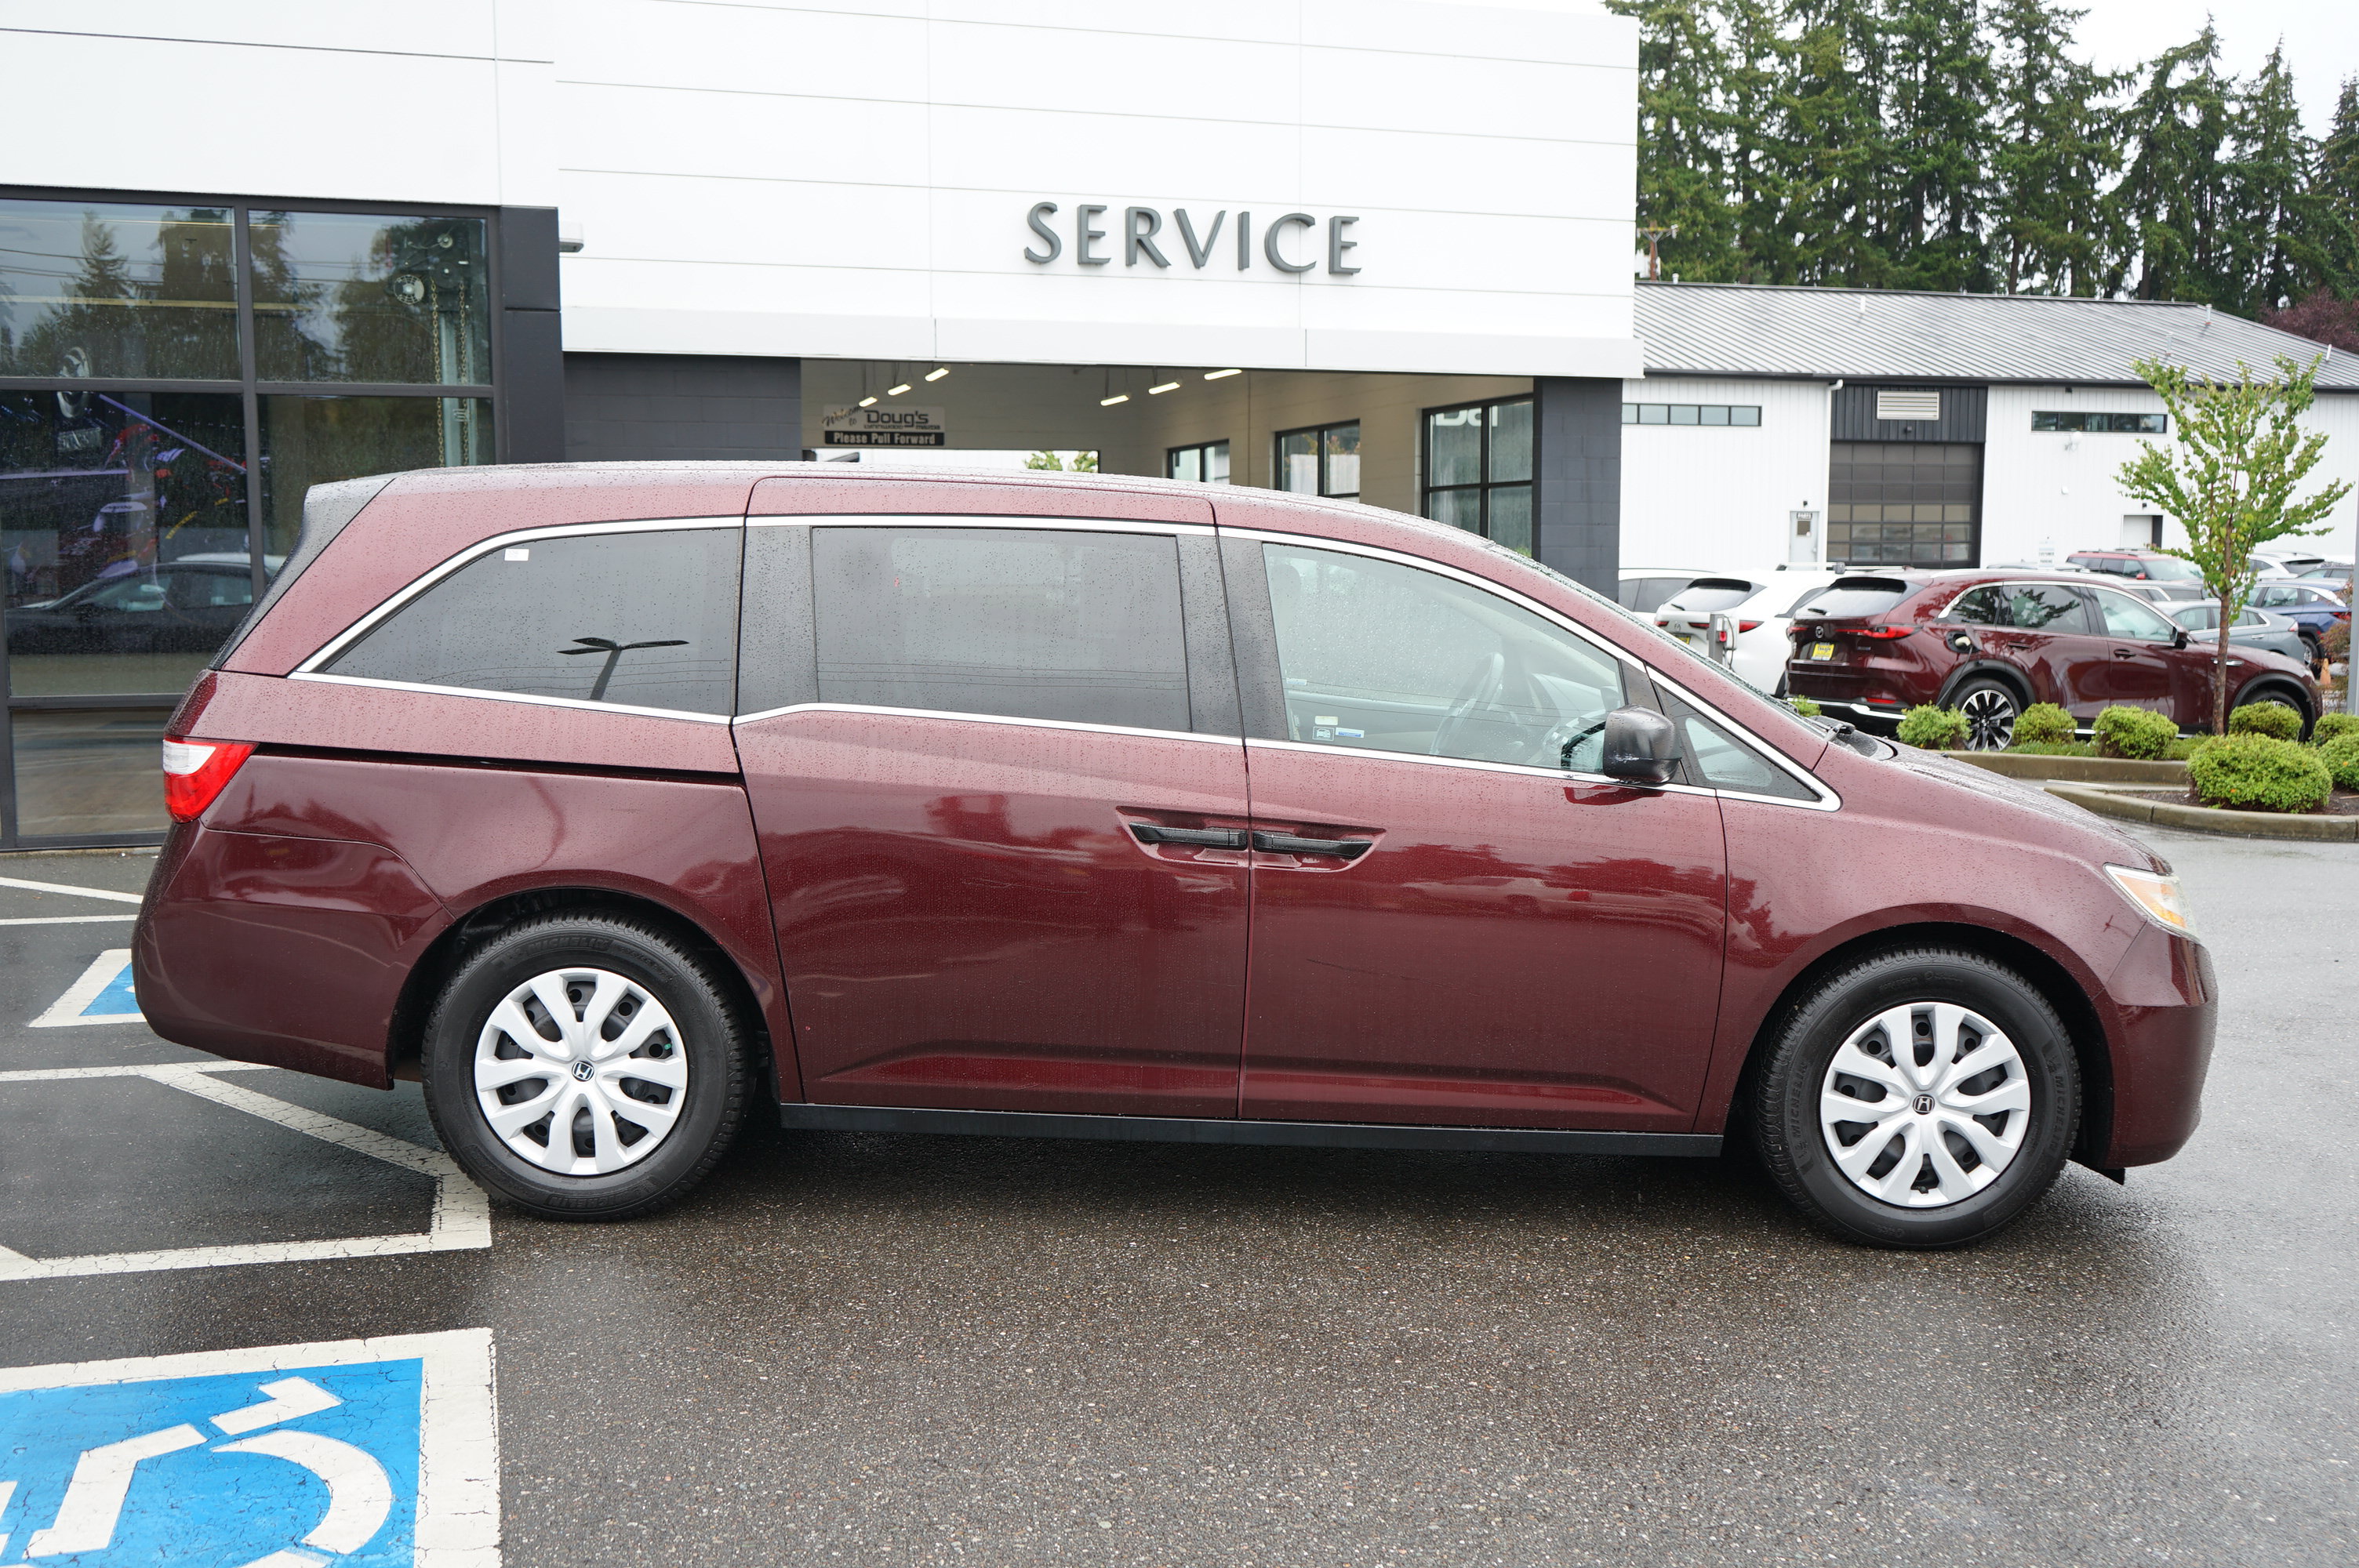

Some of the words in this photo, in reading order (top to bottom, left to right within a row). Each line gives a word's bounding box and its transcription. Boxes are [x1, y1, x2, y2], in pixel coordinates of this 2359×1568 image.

[1023, 201, 1362, 275] SERVICE
[822, 406, 864, 426] Welcom
[864, 410, 929, 427] Doug's
[834, 432, 867, 443] Please
[871, 433, 890, 444] Pull
[894, 433, 935, 444] Forward
[527, 937, 611, 956] MICHELIN
